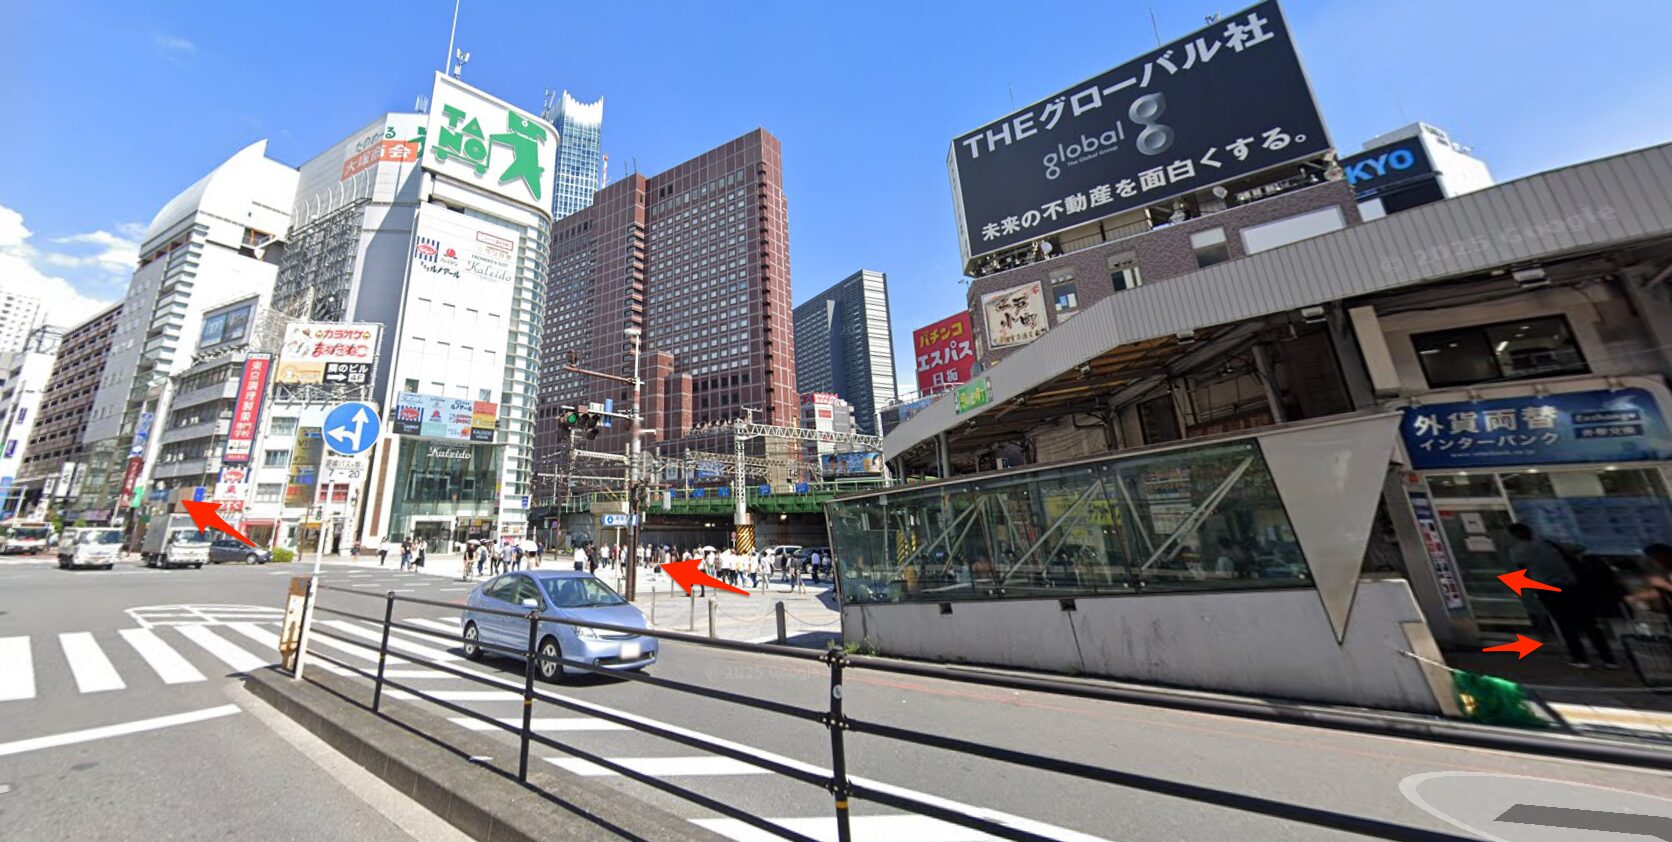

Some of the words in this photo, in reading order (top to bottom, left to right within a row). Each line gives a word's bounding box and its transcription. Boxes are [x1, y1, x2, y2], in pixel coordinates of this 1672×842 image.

[1042, 120, 1126, 180] global
[1078, 152, 1098, 163] Global
[981, 126, 1309, 242] 未来の不動産を面白くする。
[465, 259, 512, 282] Kaleido
[322, 329, 364, 340] カラオケ
[919, 321, 964, 349] パチンコ
[311, 341, 368, 358] まねきねこ
[917, 340, 974, 372] エスパス
[327, 364, 369, 374] 隣のビル
[1412, 404, 1559, 437] 外貨両替
[427, 446, 472, 459] Kaleido
[1419, 431, 1560, 453] インターバンク
